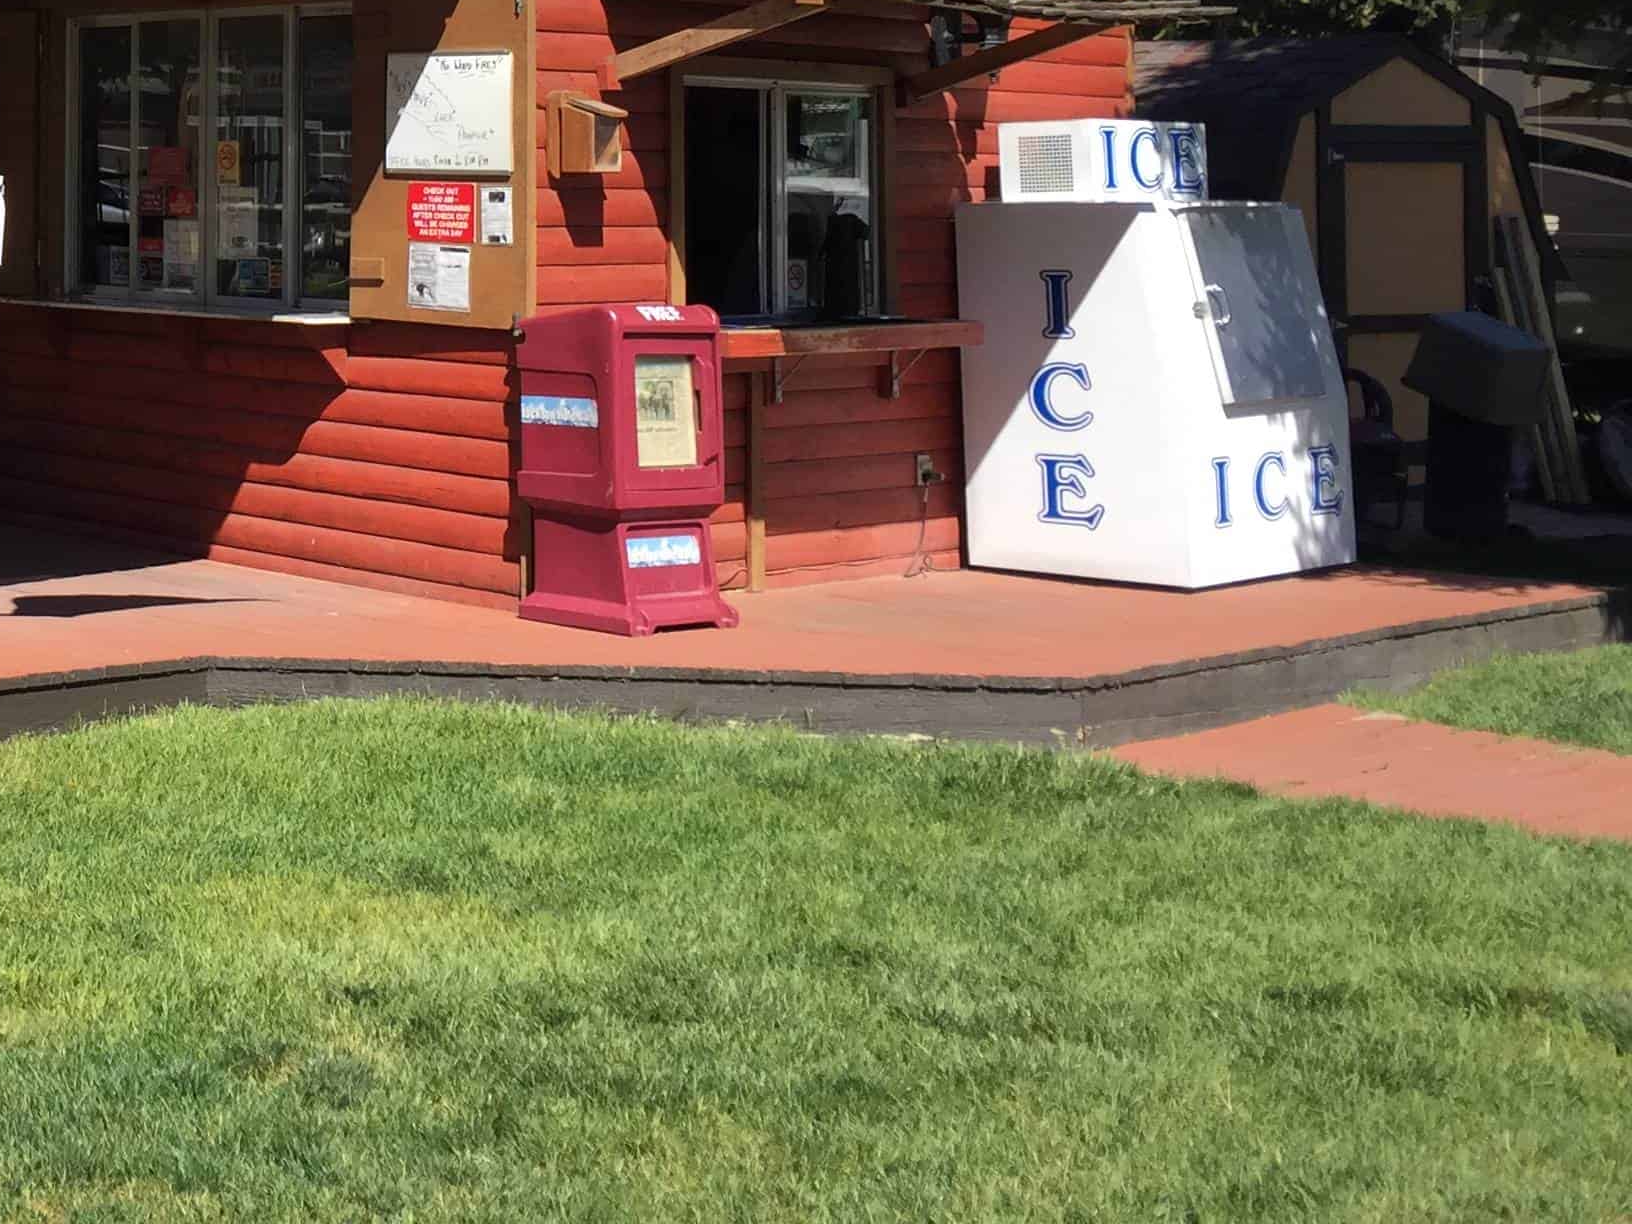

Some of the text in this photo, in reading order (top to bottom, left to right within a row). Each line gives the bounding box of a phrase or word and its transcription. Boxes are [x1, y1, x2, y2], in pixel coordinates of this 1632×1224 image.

[1098, 124, 1206, 195] ICE
[1028, 269, 1105, 531] ICE
[1210, 440, 1345, 529] ICE
